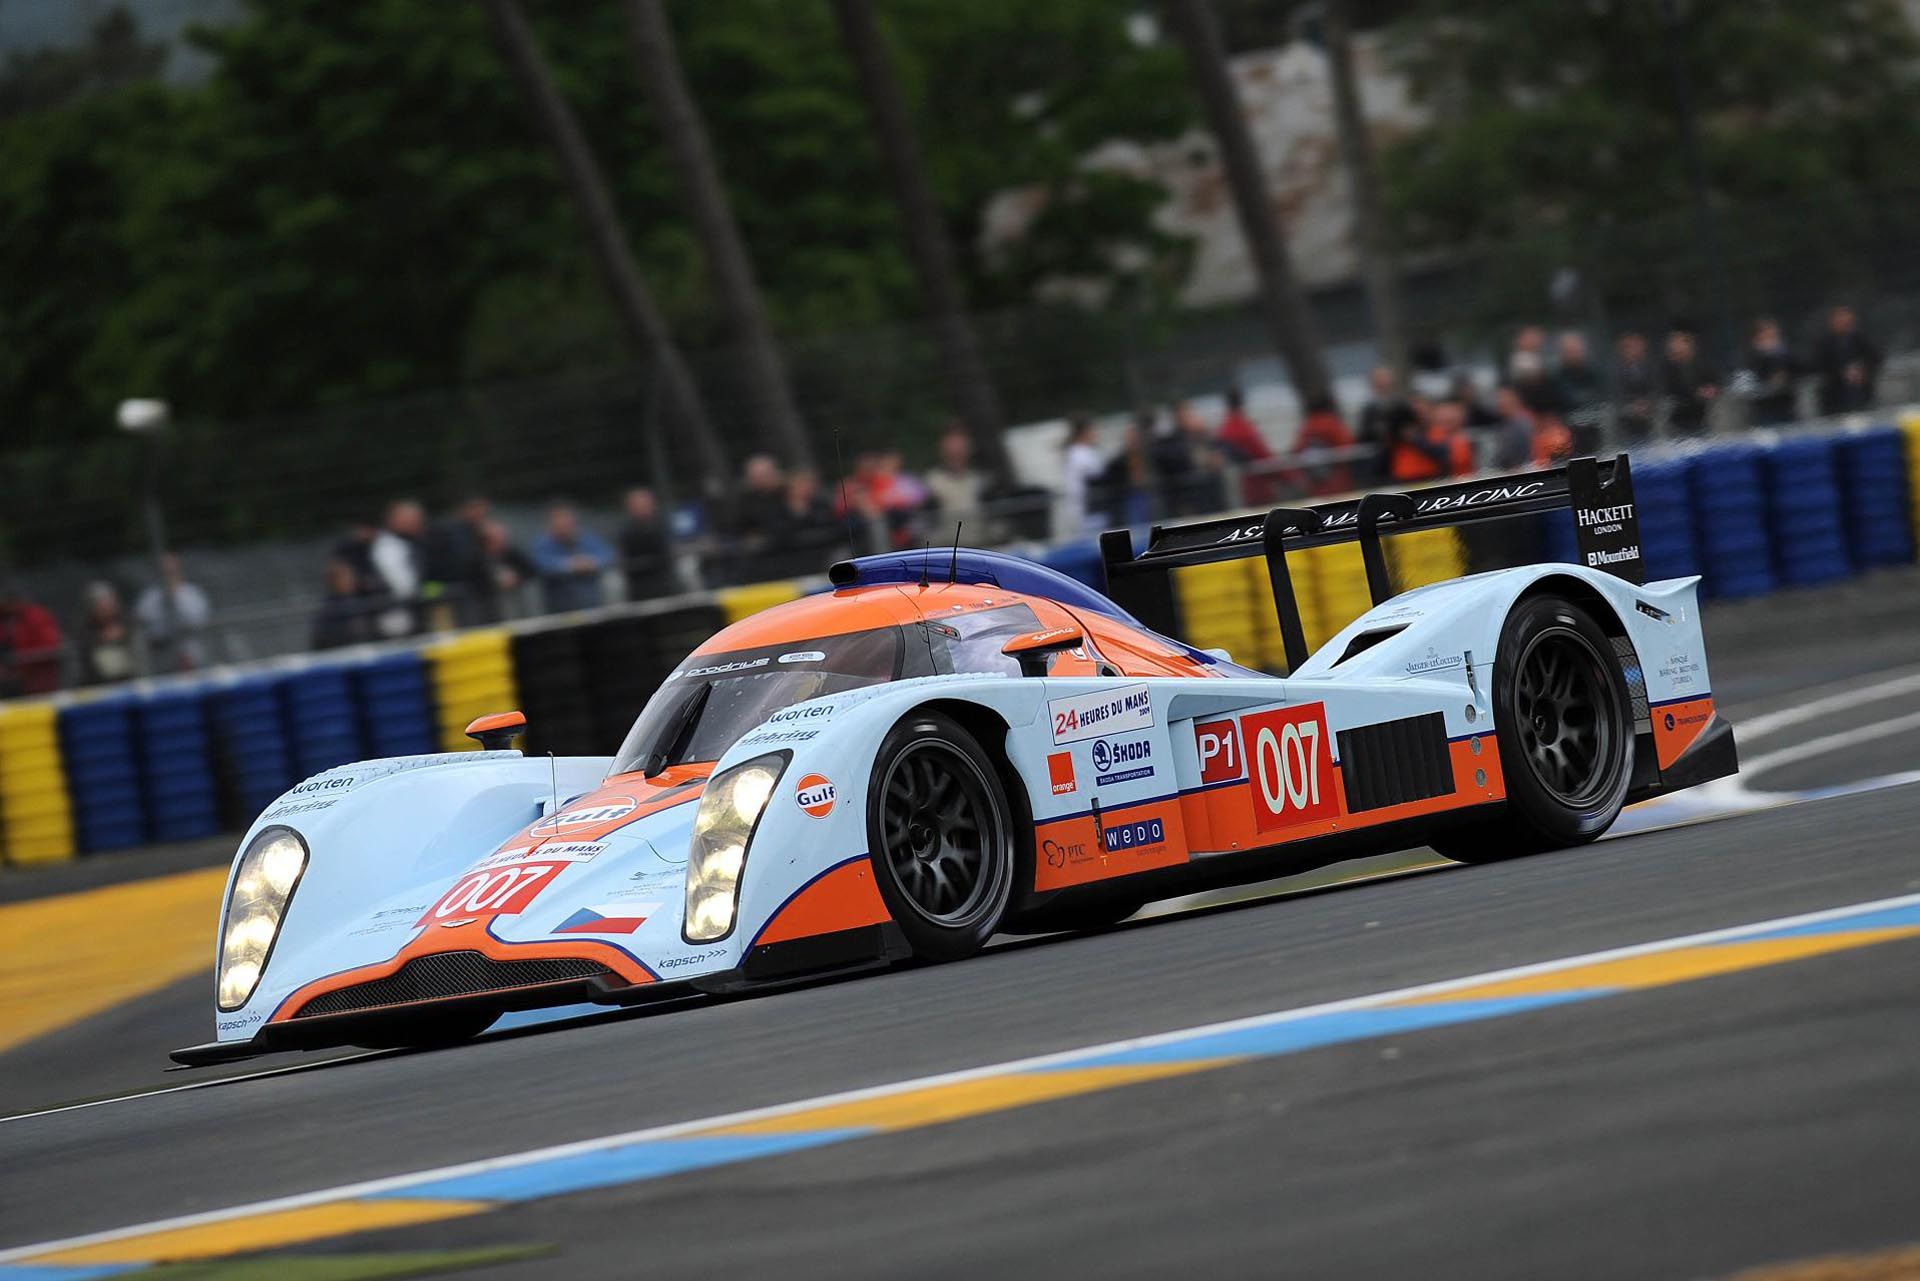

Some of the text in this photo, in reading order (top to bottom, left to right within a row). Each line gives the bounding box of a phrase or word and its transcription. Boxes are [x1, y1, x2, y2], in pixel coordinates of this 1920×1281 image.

[1425, 482, 1545, 511] RACING
[1577, 504, 1634, 527] HACKETT
[1593, 523, 1623, 535] LONDON
[1596, 545, 1640, 565] Mountfield
[770, 705, 834, 723] worten
[1055, 690, 1149, 736] 24 HEURES DU MANS
[1112, 740, 1151, 764] ŠKODA
[1199, 730, 1234, 772] P1
[1256, 720, 1320, 815] 007
[292, 777, 354, 795] worten
[797, 786, 836, 806] Gulf
[1052, 782, 1074, 793] orange
[564, 845, 604, 854] MANS
[435, 865, 554, 918] 007
[658, 953, 706, 969] kapsch
